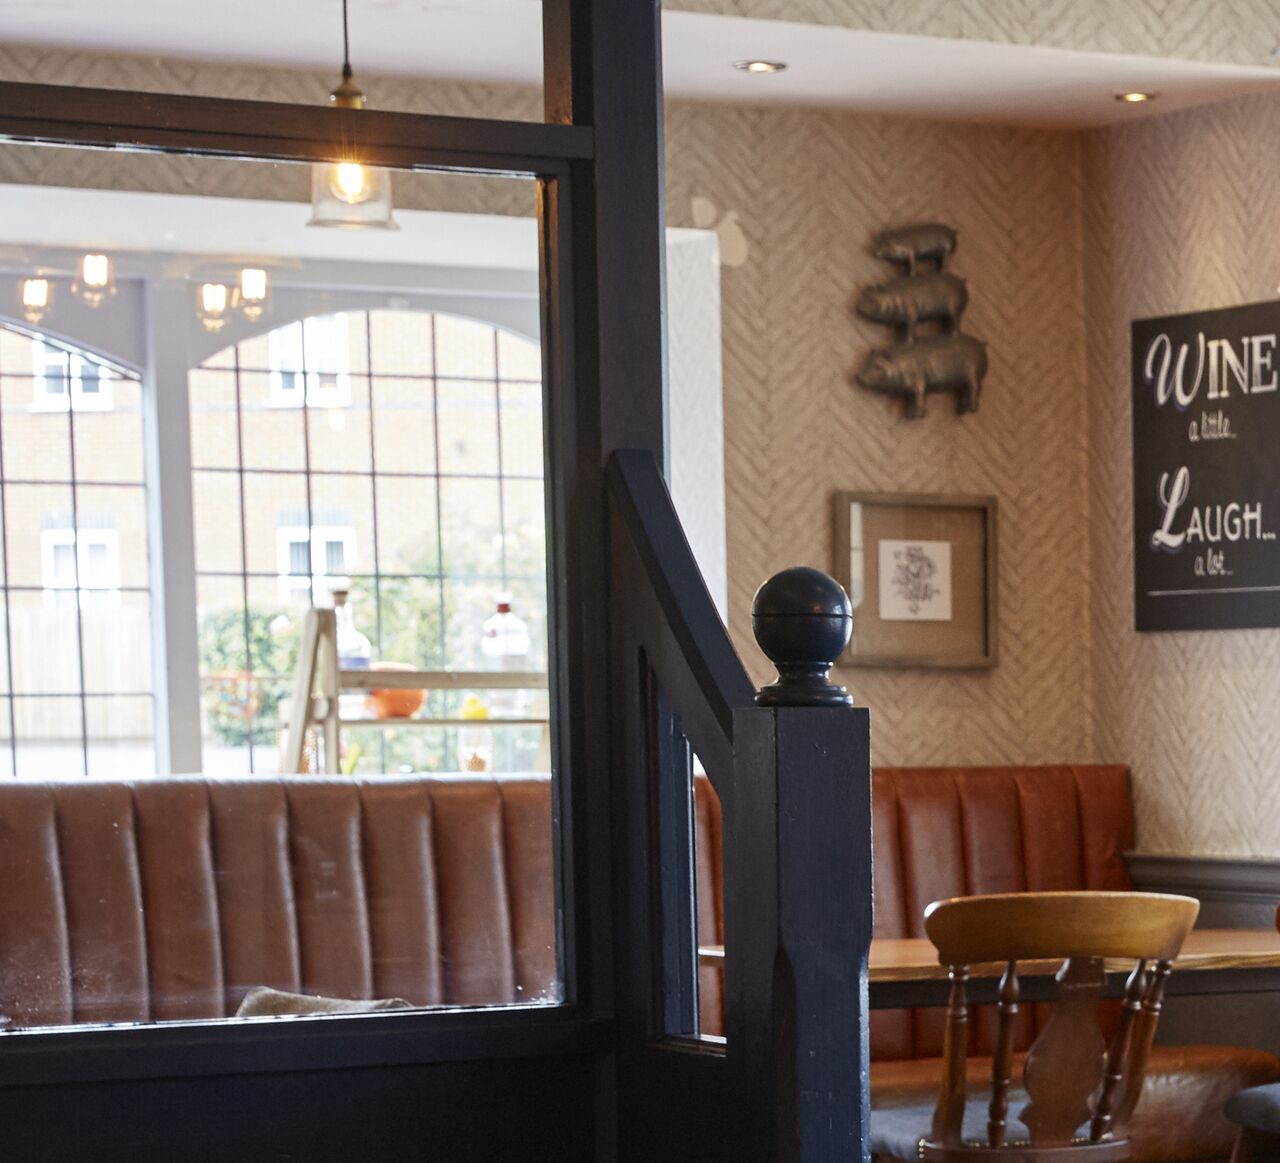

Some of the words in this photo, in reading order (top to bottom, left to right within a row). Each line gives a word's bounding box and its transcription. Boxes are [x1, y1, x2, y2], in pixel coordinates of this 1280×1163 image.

[1145, 331, 1278, 406] WINE
[1188, 420, 1200, 442] a
[1194, 555, 1206, 576] a
